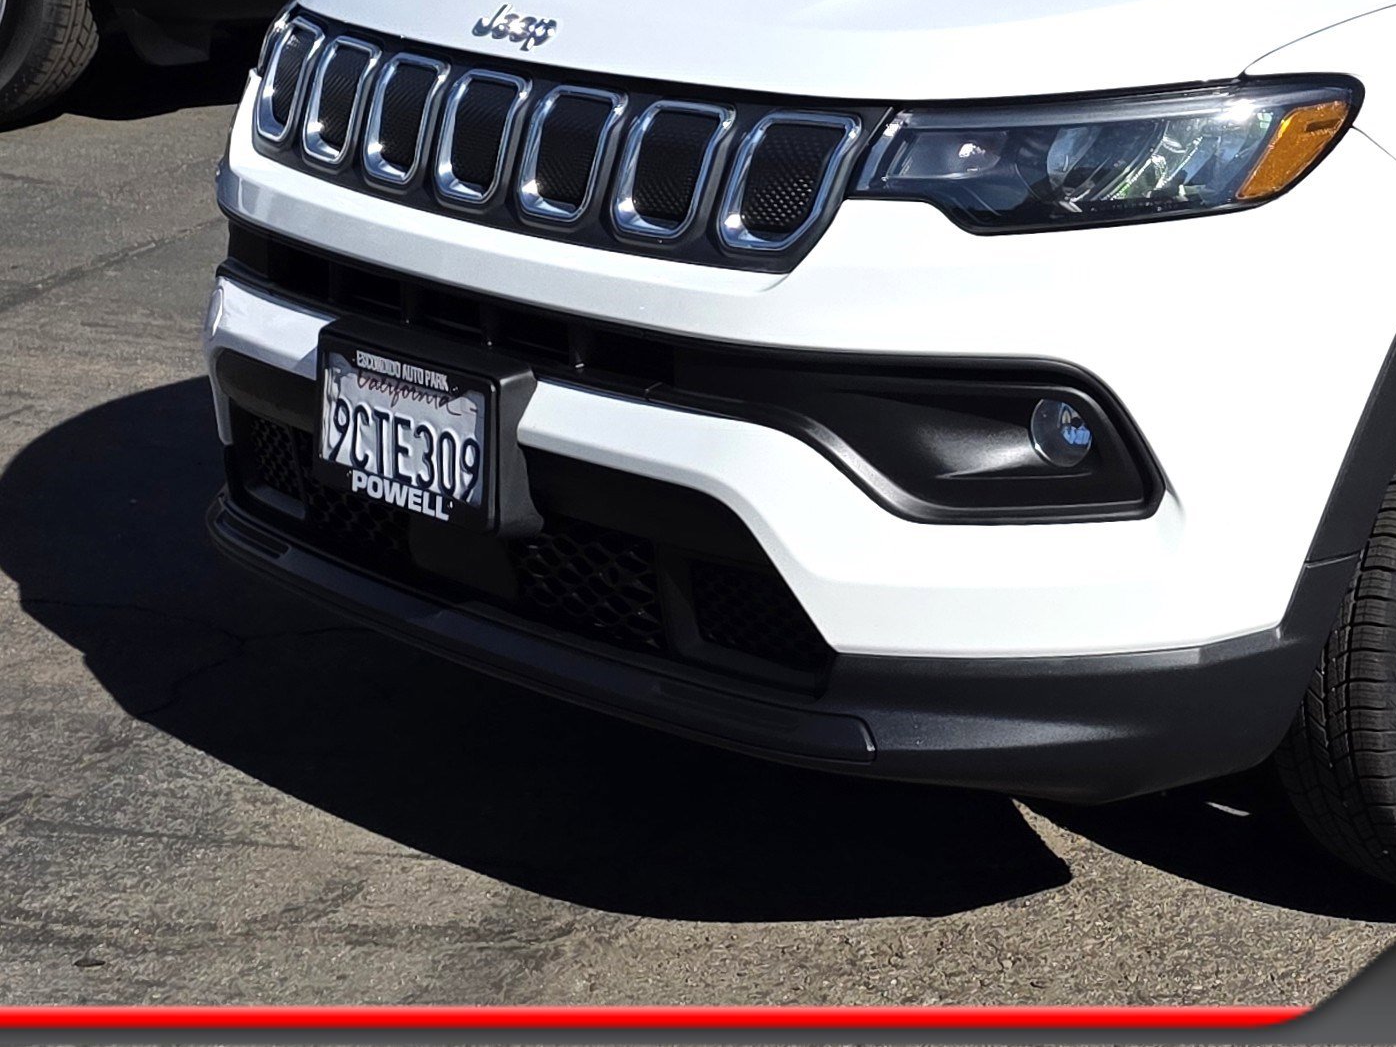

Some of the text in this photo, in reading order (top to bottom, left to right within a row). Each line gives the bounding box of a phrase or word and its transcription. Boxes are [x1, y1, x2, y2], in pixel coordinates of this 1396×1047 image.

[471, 3, 558, 51] Jeep
[356, 350, 449, 392] ESCONDIDO AUTO PARK
[330, 398, 481, 503] 9CTE309
[352, 469, 449, 522] POWELL
